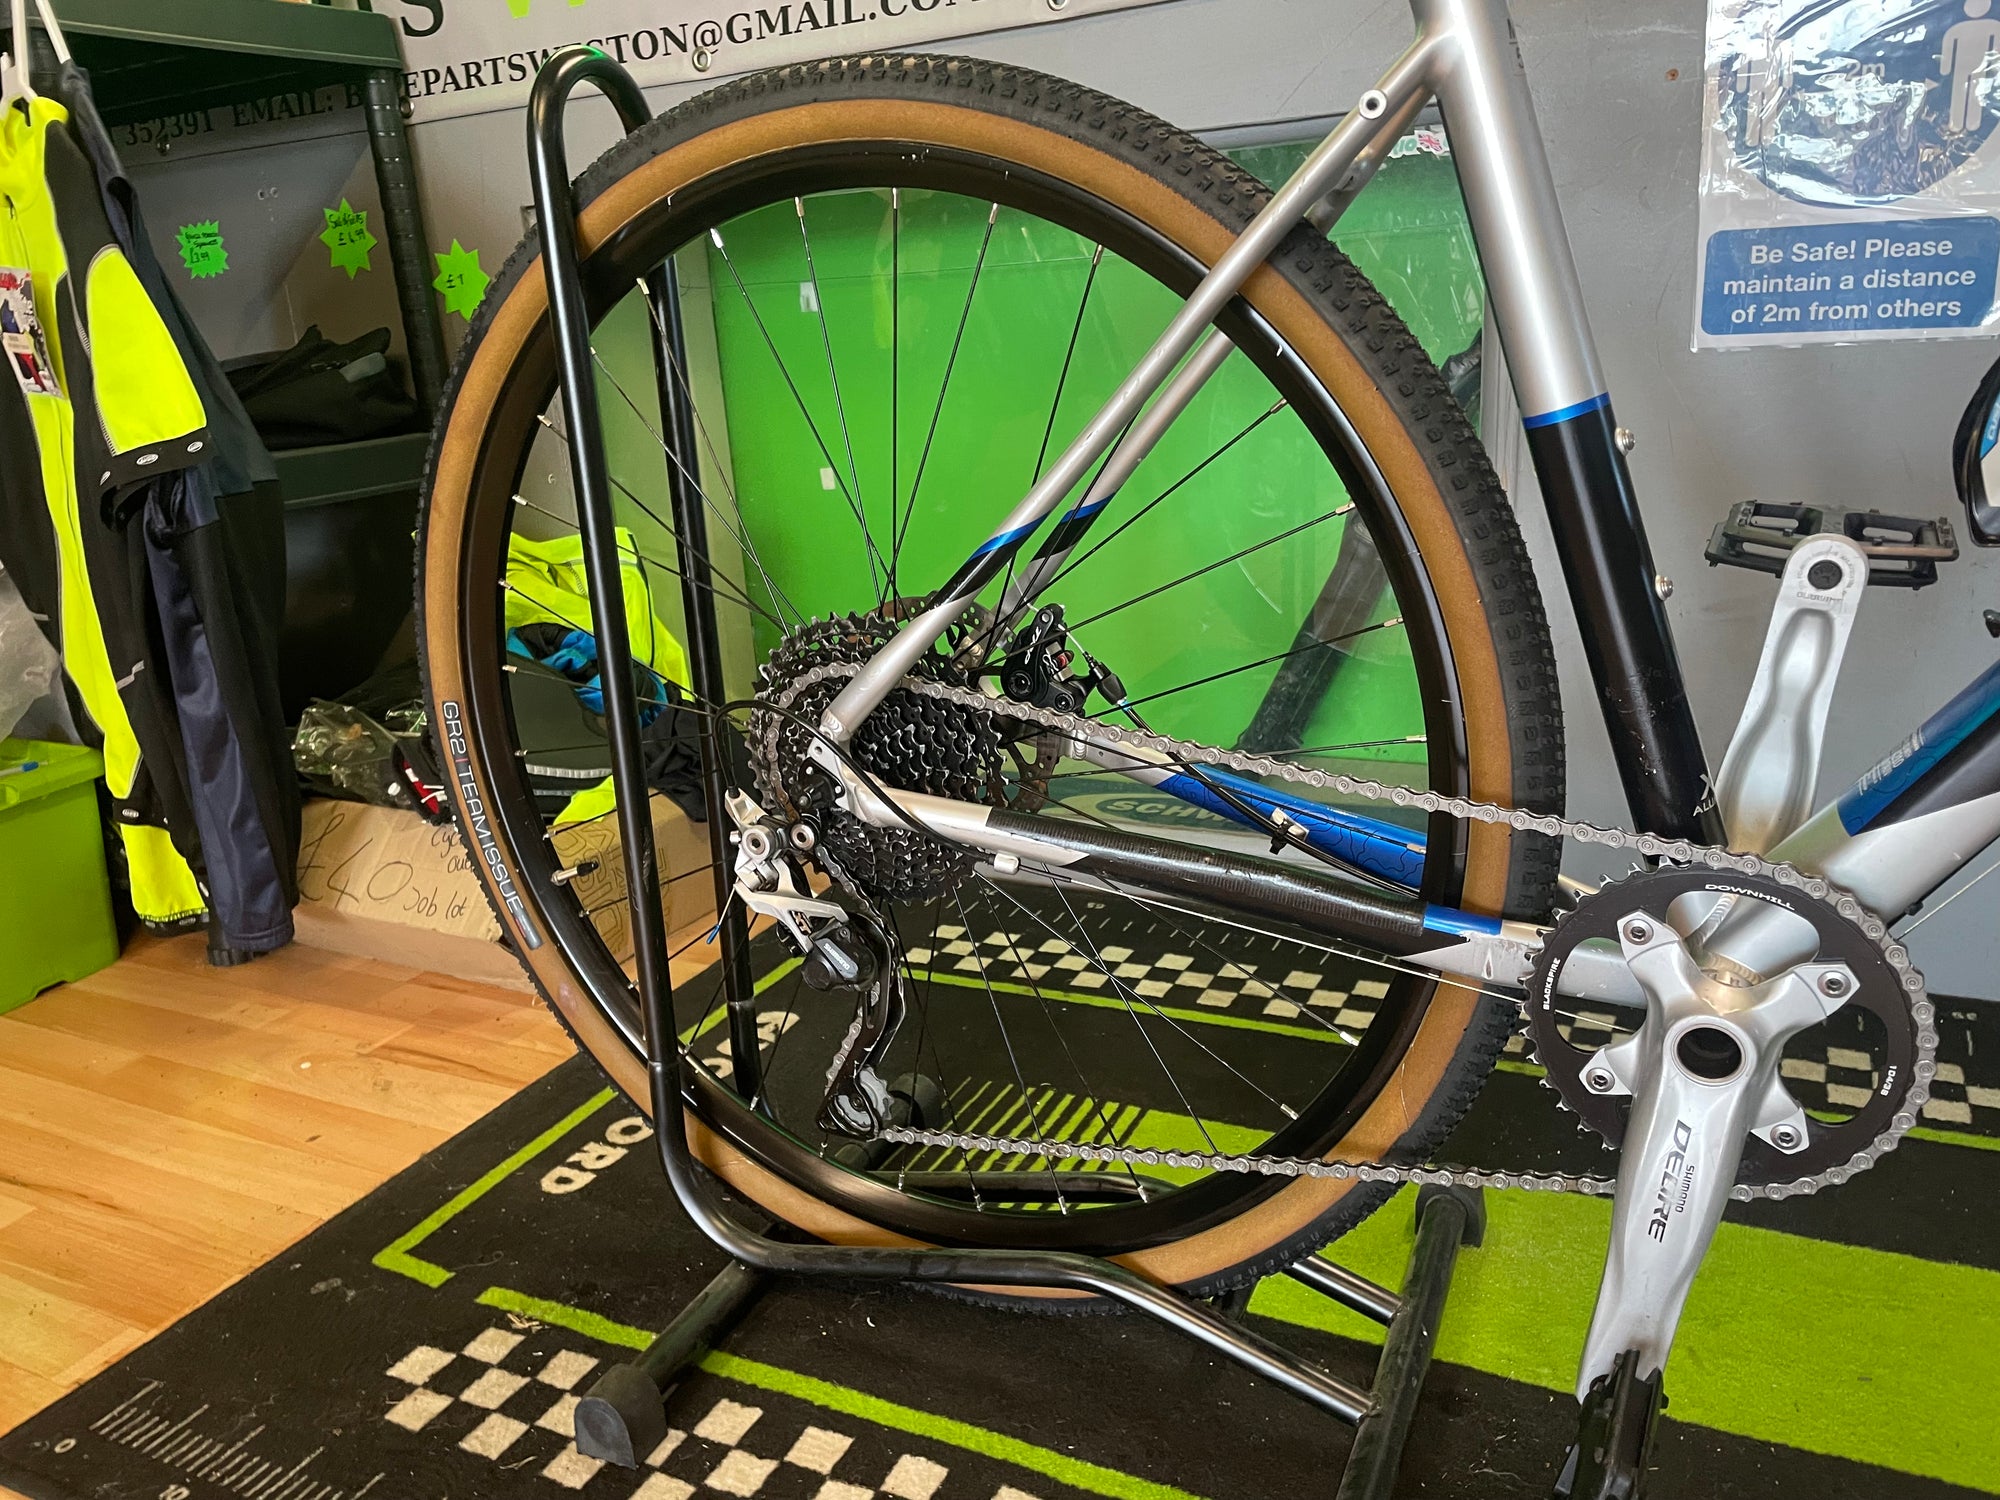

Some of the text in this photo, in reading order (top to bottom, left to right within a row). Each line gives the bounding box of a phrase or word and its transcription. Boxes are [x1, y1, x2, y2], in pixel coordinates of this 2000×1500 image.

[1750, 239, 1953, 265] Be Safe! Please
[446, 273, 464, 289] £1
[1723, 269, 1977, 294] maintain a distance
[1731, 299, 1961, 324] of 2m from others
[443, 702, 524, 914] GR2 TEAM ISSUE
[298, 813, 414, 909] £40
[1705, 884, 1795, 911] DOWNHILL
[1675, 1164, 1695, 1213] SHIMANO
